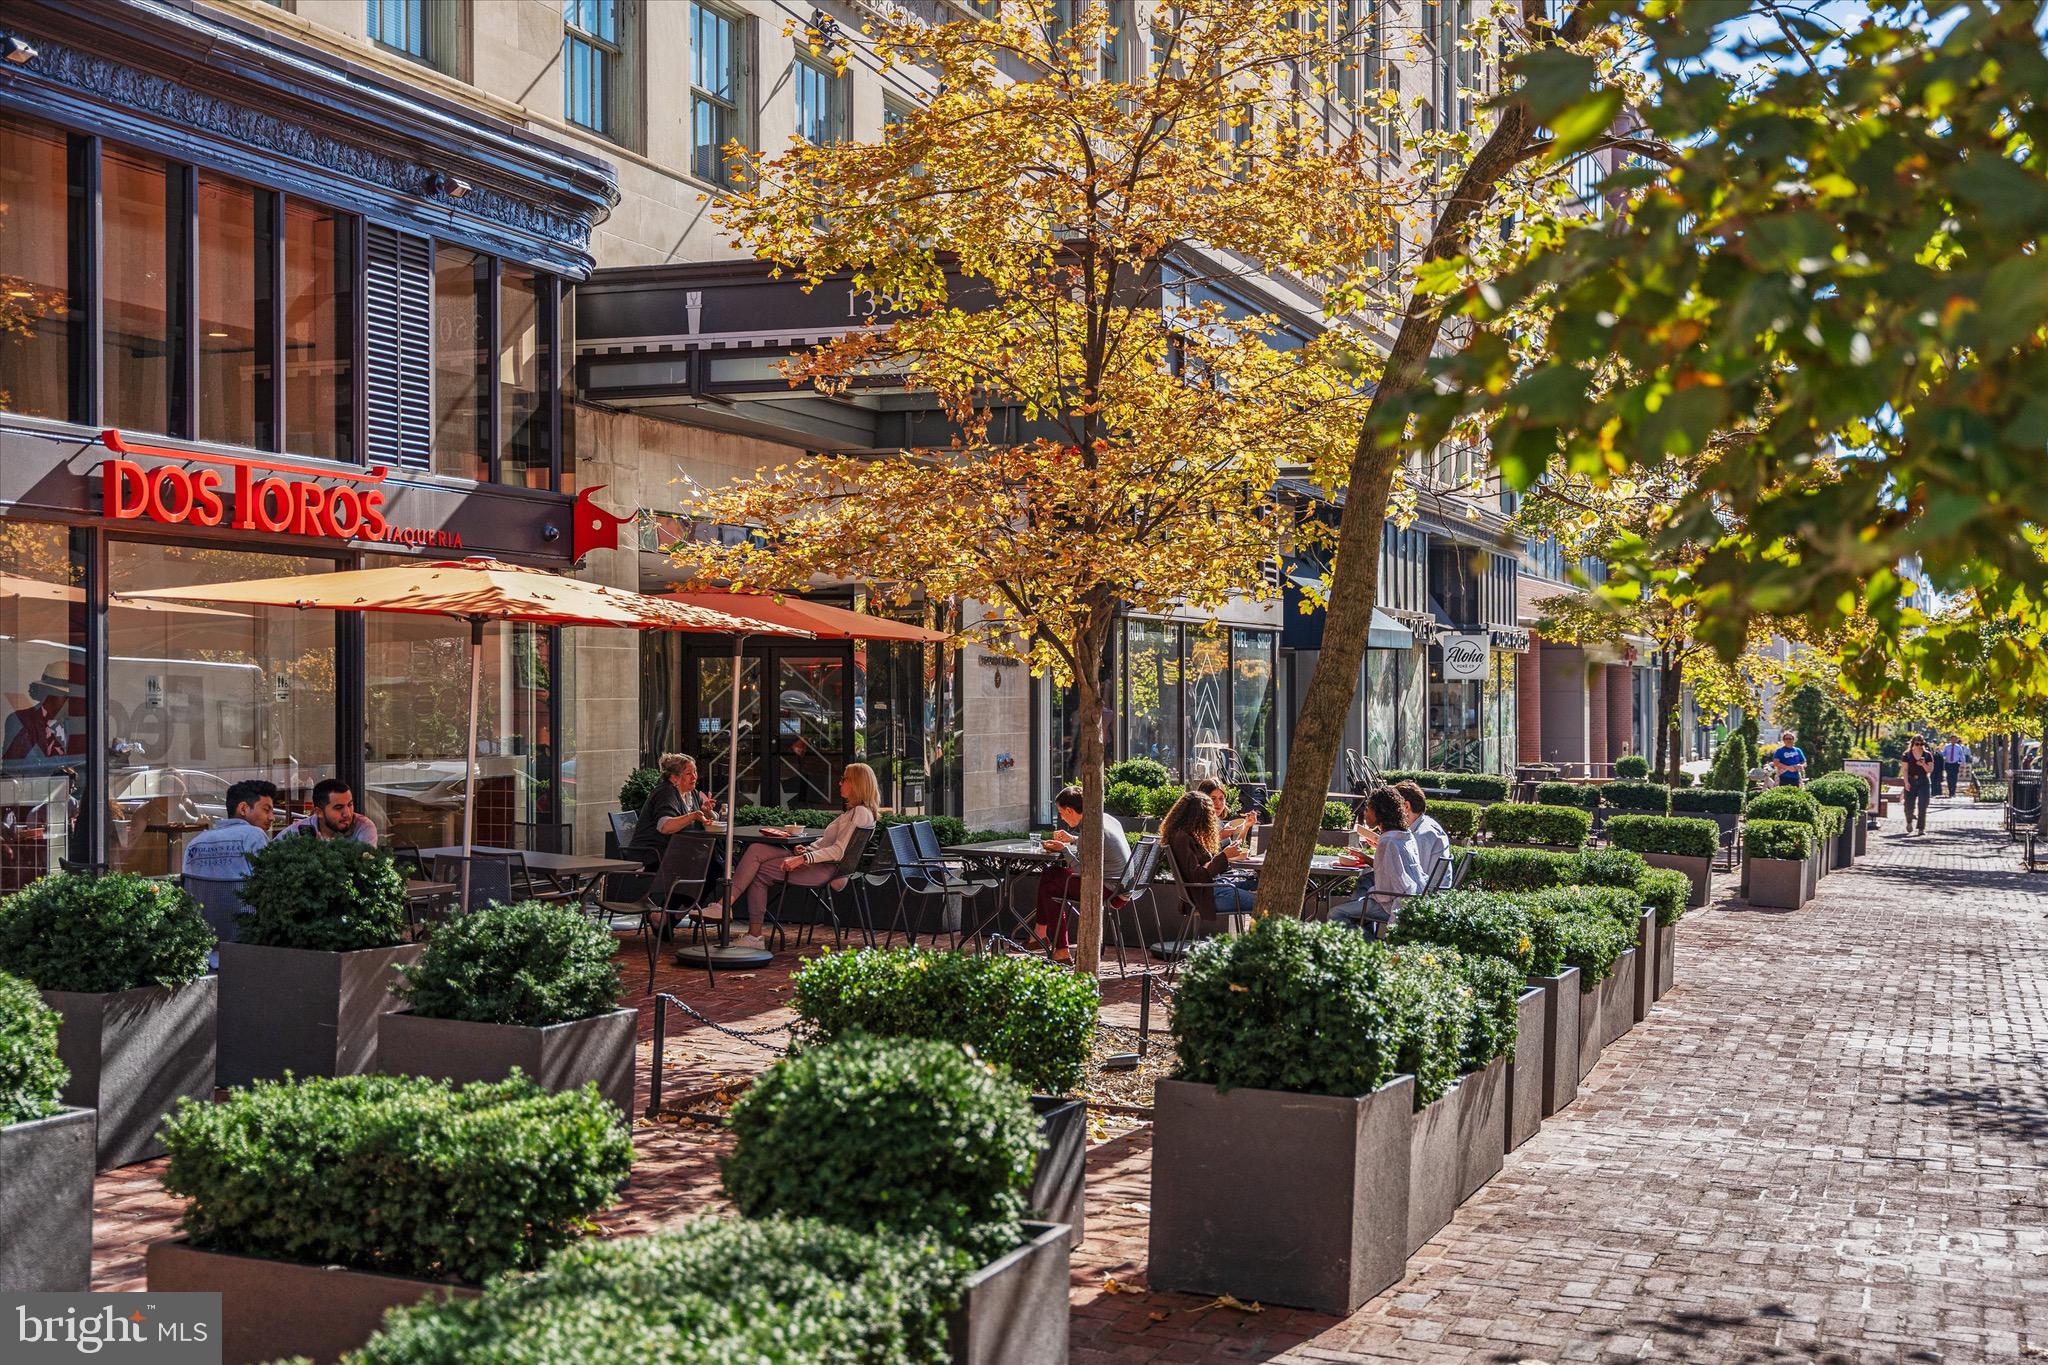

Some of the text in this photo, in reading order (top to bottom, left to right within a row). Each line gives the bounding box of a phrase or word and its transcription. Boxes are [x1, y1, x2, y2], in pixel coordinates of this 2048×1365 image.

[103, 459, 387, 541] DOS TOROS
[385, 524, 463, 550] TAQUERIA
[1129, 621, 1145, 641] RUN
[1233, 631, 1248, 648] FUEL
[1445, 646, 1485, 663] Aloha
